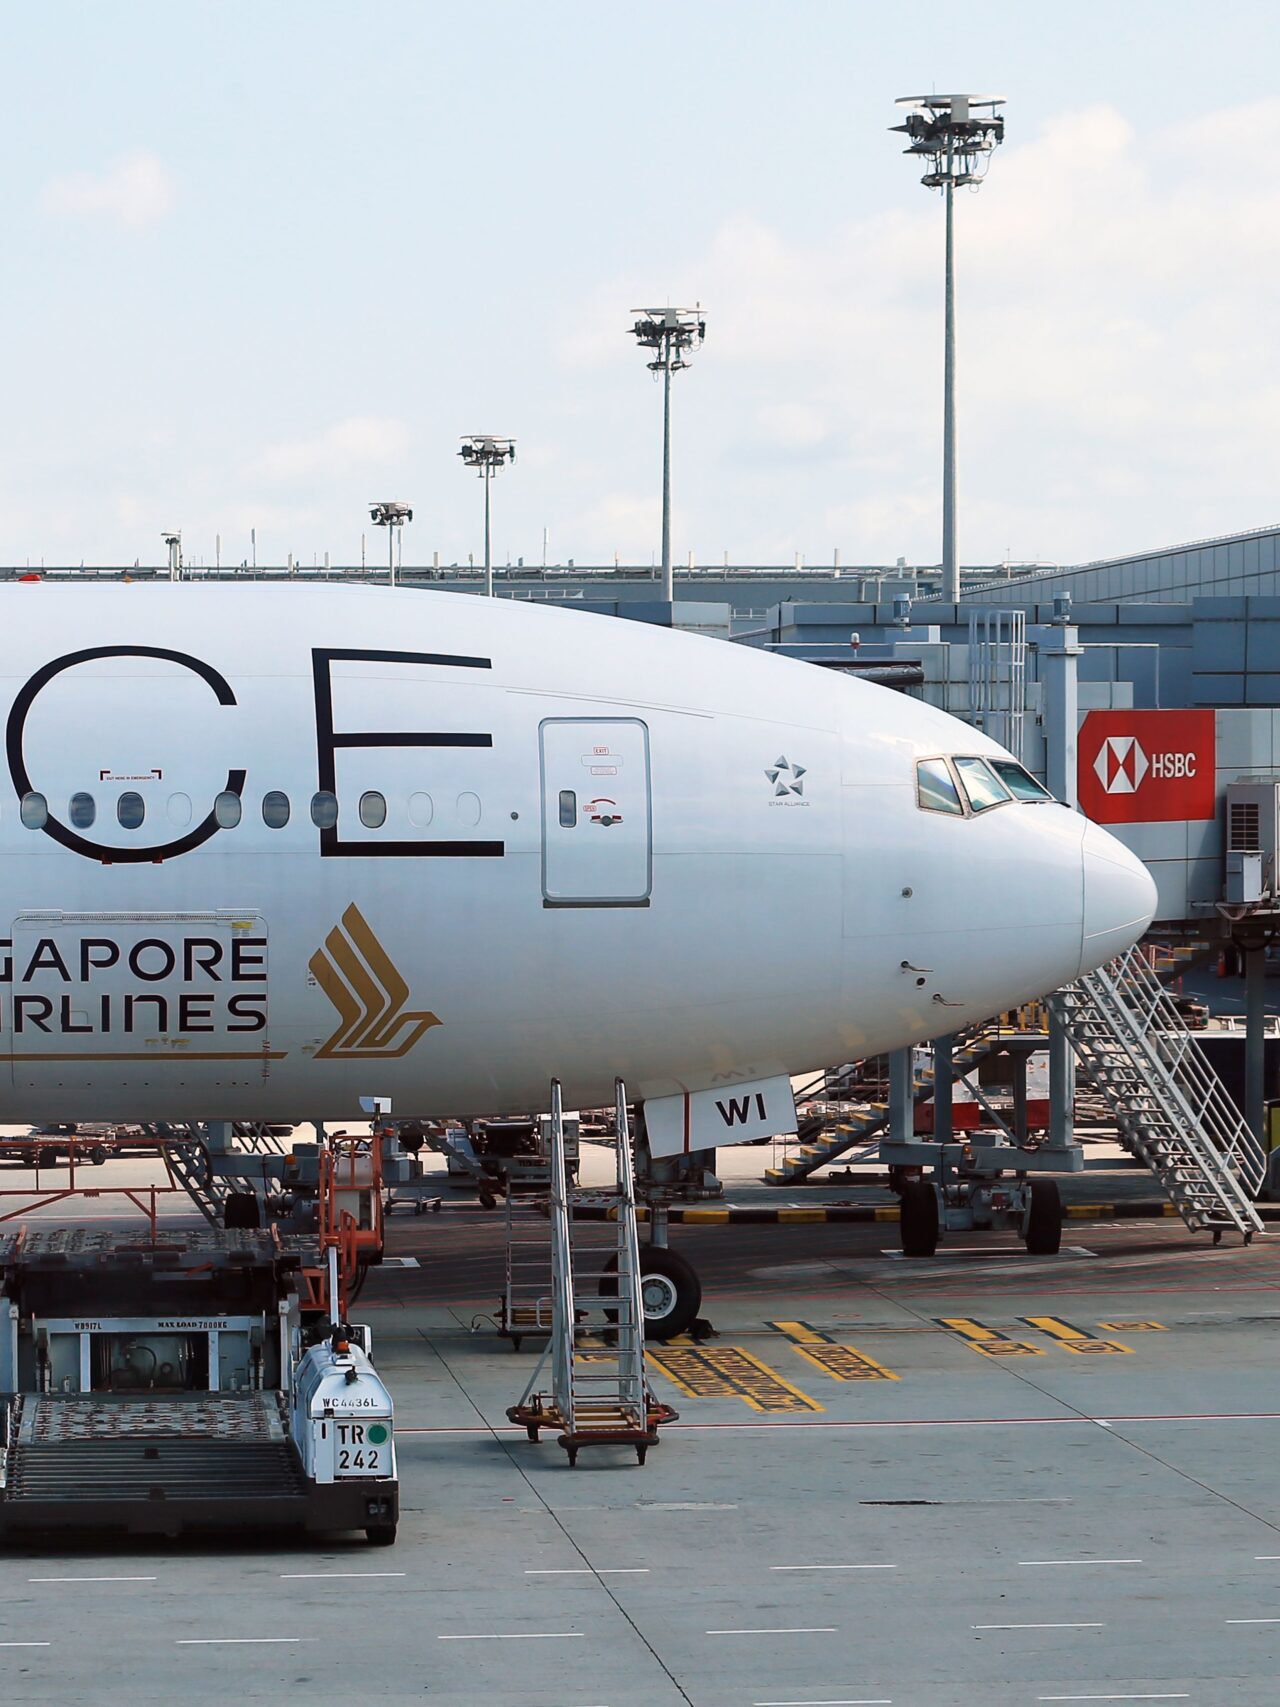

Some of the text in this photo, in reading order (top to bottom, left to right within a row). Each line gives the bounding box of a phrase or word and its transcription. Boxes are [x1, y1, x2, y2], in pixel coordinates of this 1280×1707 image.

[1152, 752, 1196, 778] HSBC
[715, 1092, 767, 1127] WI
[322, 1398, 379, 1407] WC4436L
[337, 1425, 364, 1444] TR
[339, 1450, 378, 1469] 242
